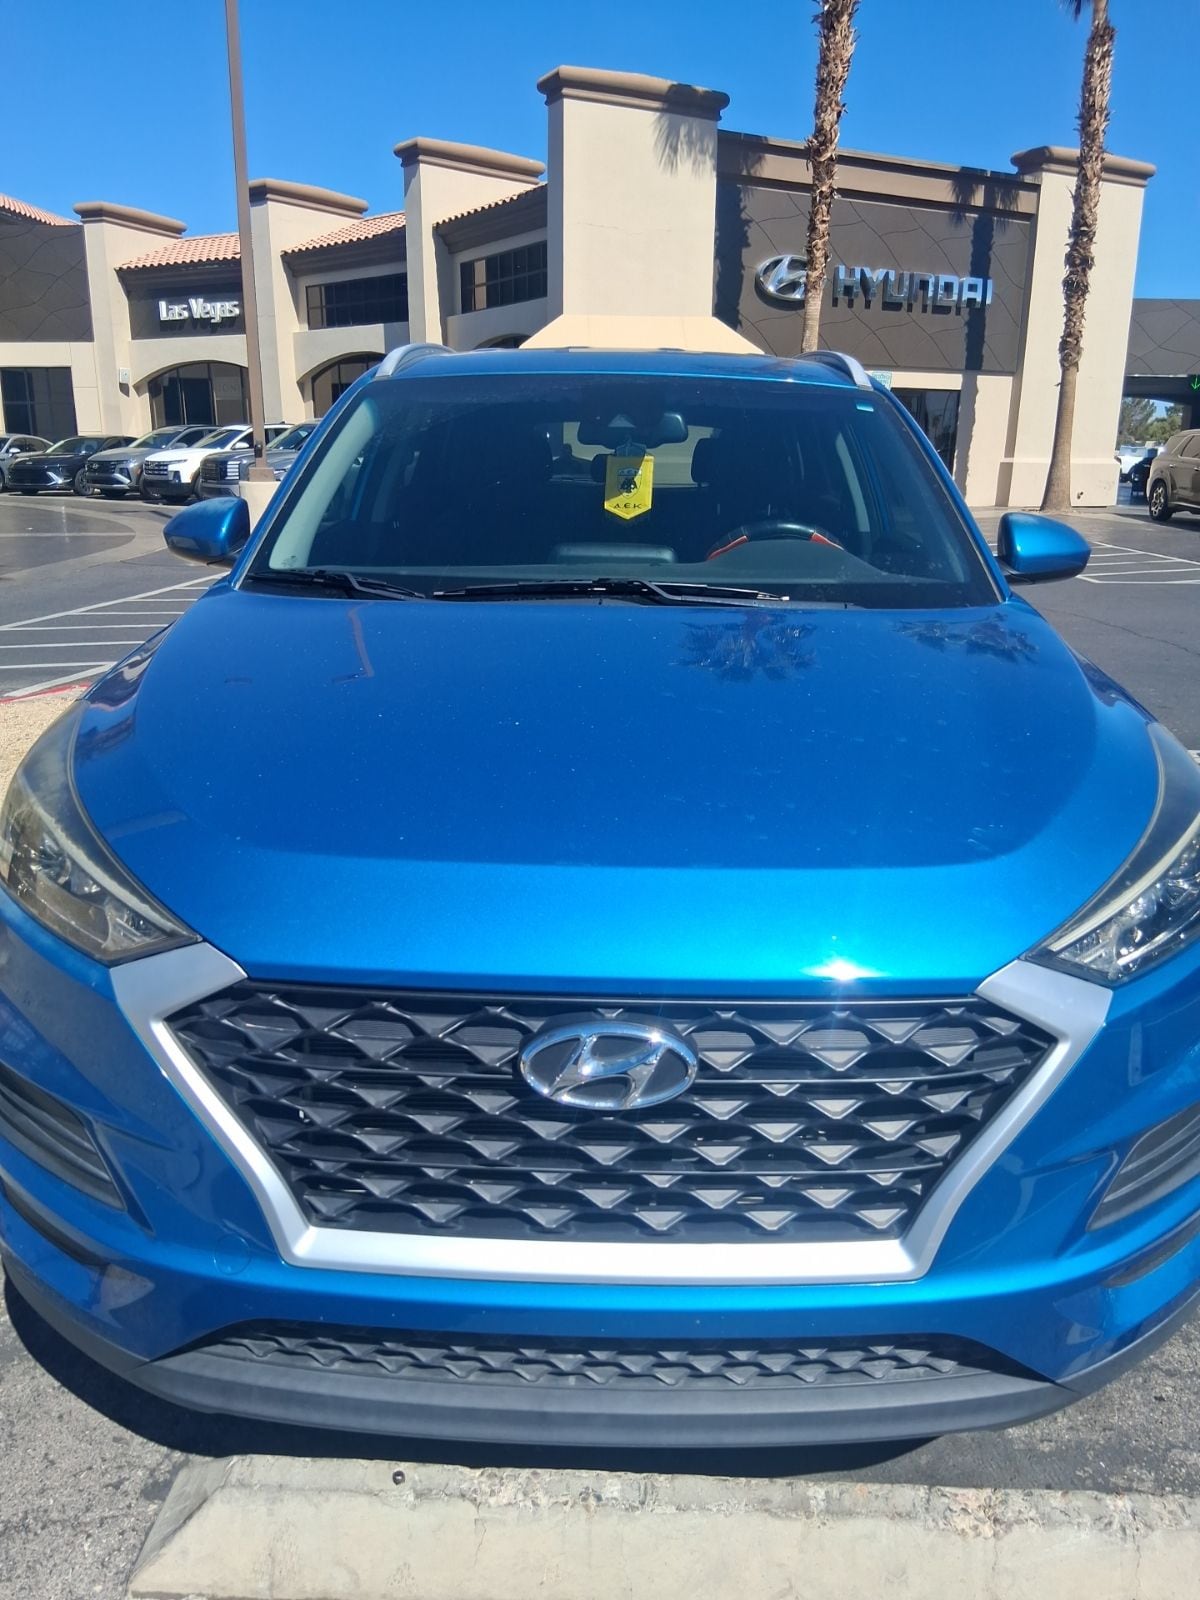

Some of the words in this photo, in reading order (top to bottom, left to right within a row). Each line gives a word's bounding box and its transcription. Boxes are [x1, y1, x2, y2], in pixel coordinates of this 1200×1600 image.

[832, 265, 993, 309] HYUNDAI
[159, 301, 188, 320] Las
[188, 298, 240, 323] Vegas
